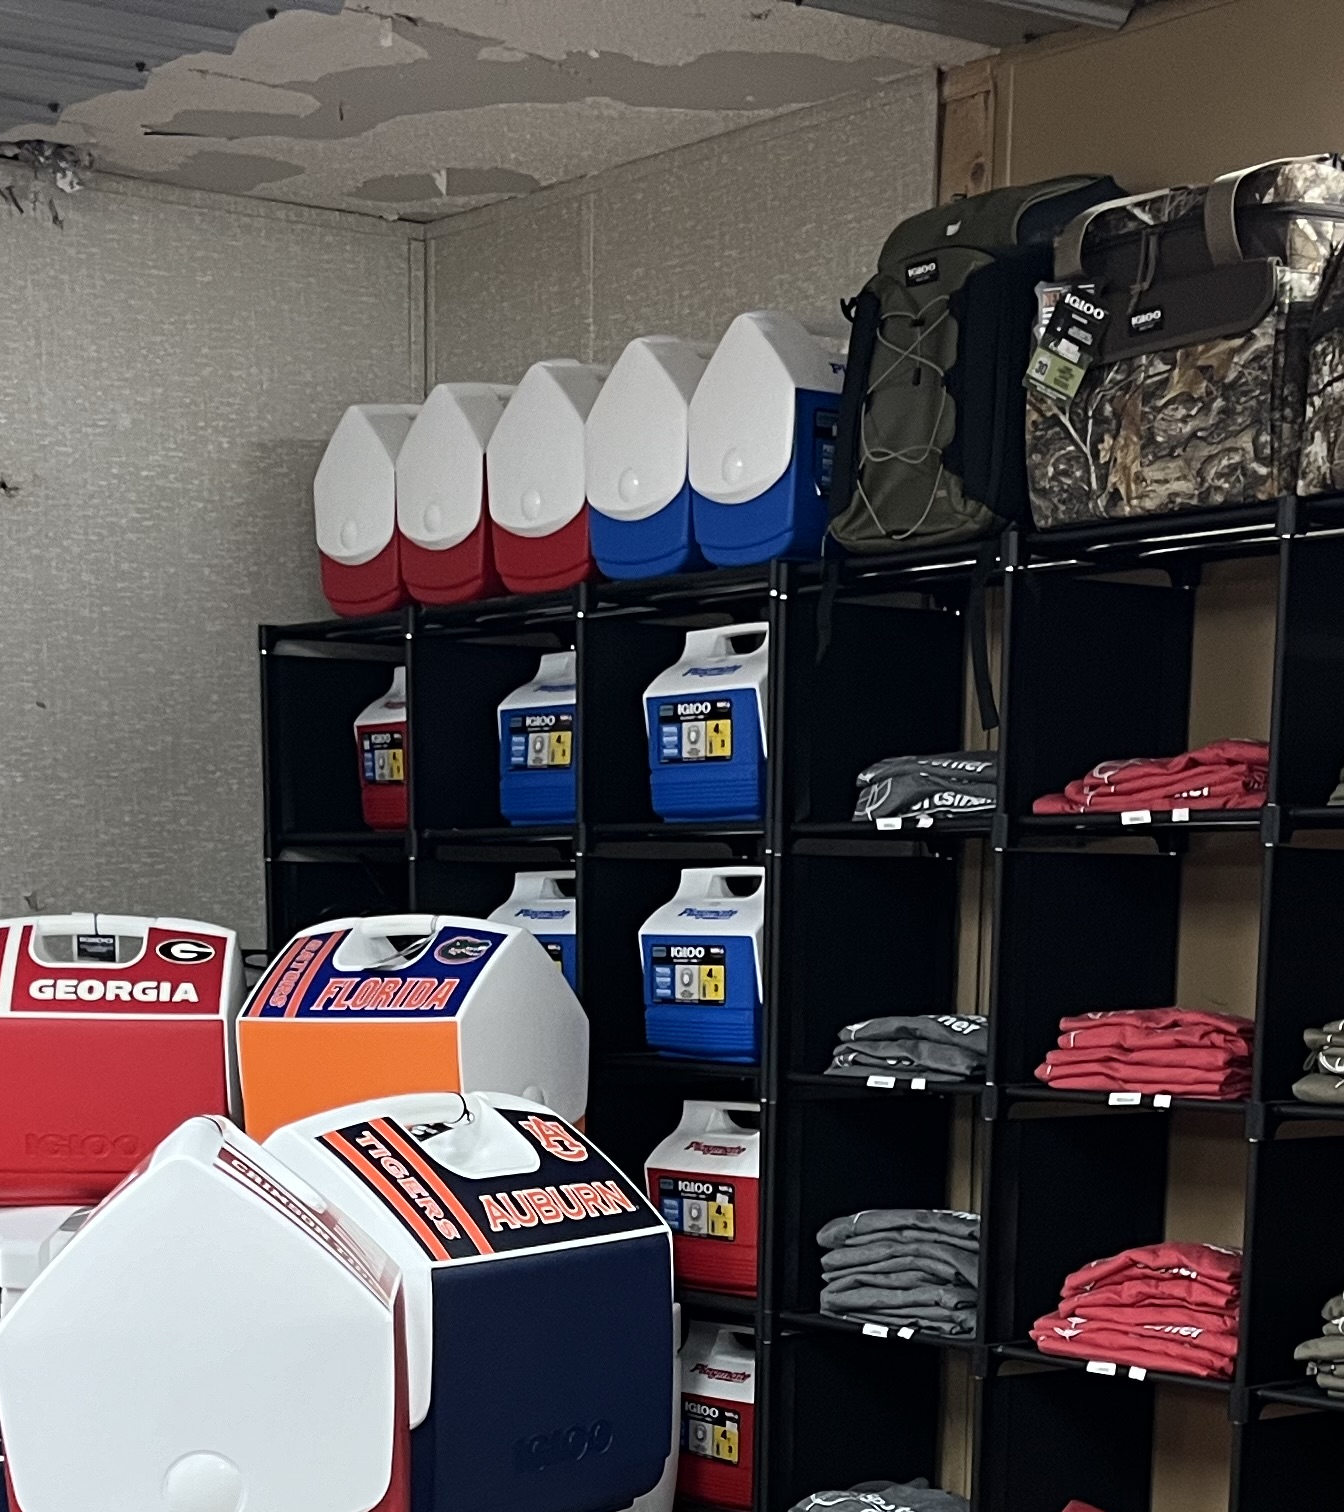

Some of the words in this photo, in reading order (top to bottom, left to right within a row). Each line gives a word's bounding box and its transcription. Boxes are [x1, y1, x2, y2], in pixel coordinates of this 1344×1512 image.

[1064, 292, 1105, 321] IGLOO
[1132, 310, 1162, 327] IGLOO
[677, 701, 711, 714] IGLOO
[526, 715, 555, 727] IGLOO
[670, 946, 706, 959] IGLOO
[29, 978, 200, 1003] GEORGIA
[310, 976, 460, 1012] FLORIDA
[25, 1131, 140, 1159] IGLOO
[356, 1130, 461, 1241] TIGERS
[678, 1180, 713, 1194] IGLOO
[479, 1179, 636, 1233] AUBURN
[684, 1401, 719, 1418] IGLOO
